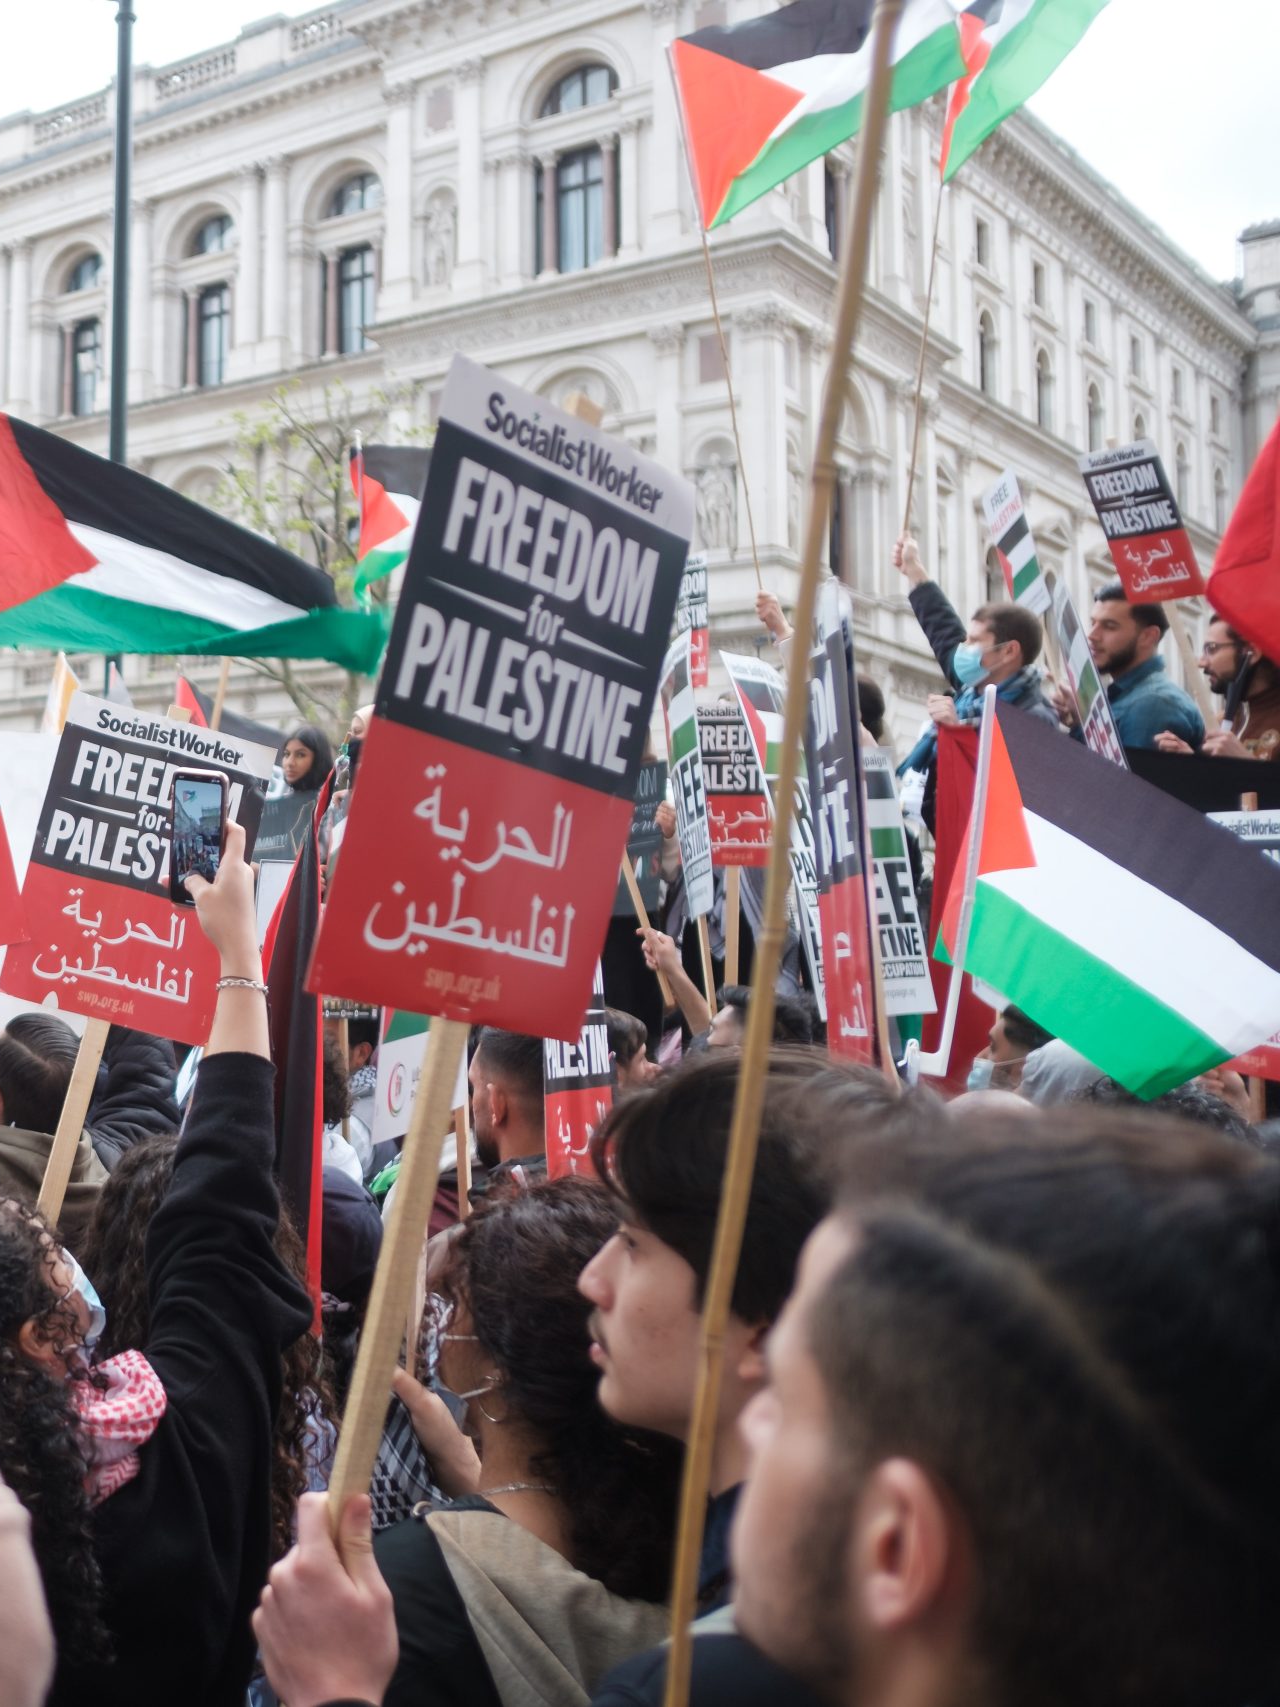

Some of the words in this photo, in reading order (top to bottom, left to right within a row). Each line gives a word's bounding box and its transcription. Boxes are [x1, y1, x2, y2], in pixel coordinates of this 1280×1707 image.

[990, 482, 1010, 512] FREE
[1090, 462, 1160, 500] FREEDOM
[1101, 500, 1178, 537] PALESTINE
[1123, 494, 1136, 507] for
[442, 456, 660, 635] FREEDOM
[1124, 538, 1173, 567] الحرية
[1131, 561, 1192, 592] لفلسطين
[526, 594, 564, 646] for
[394, 602, 642, 775] PALESTINE
[697, 706, 741, 717] Socialist
[730, 750, 746, 764] for
[137, 805, 166, 831] for
[413, 763, 573, 873] الحرية
[62, 887, 186, 950] الحرية
[363, 870, 576, 968] لفلسطين
[32, 941, 194, 1004] لفلسطين
[77, 989, 134, 1016] swp.org.uk
